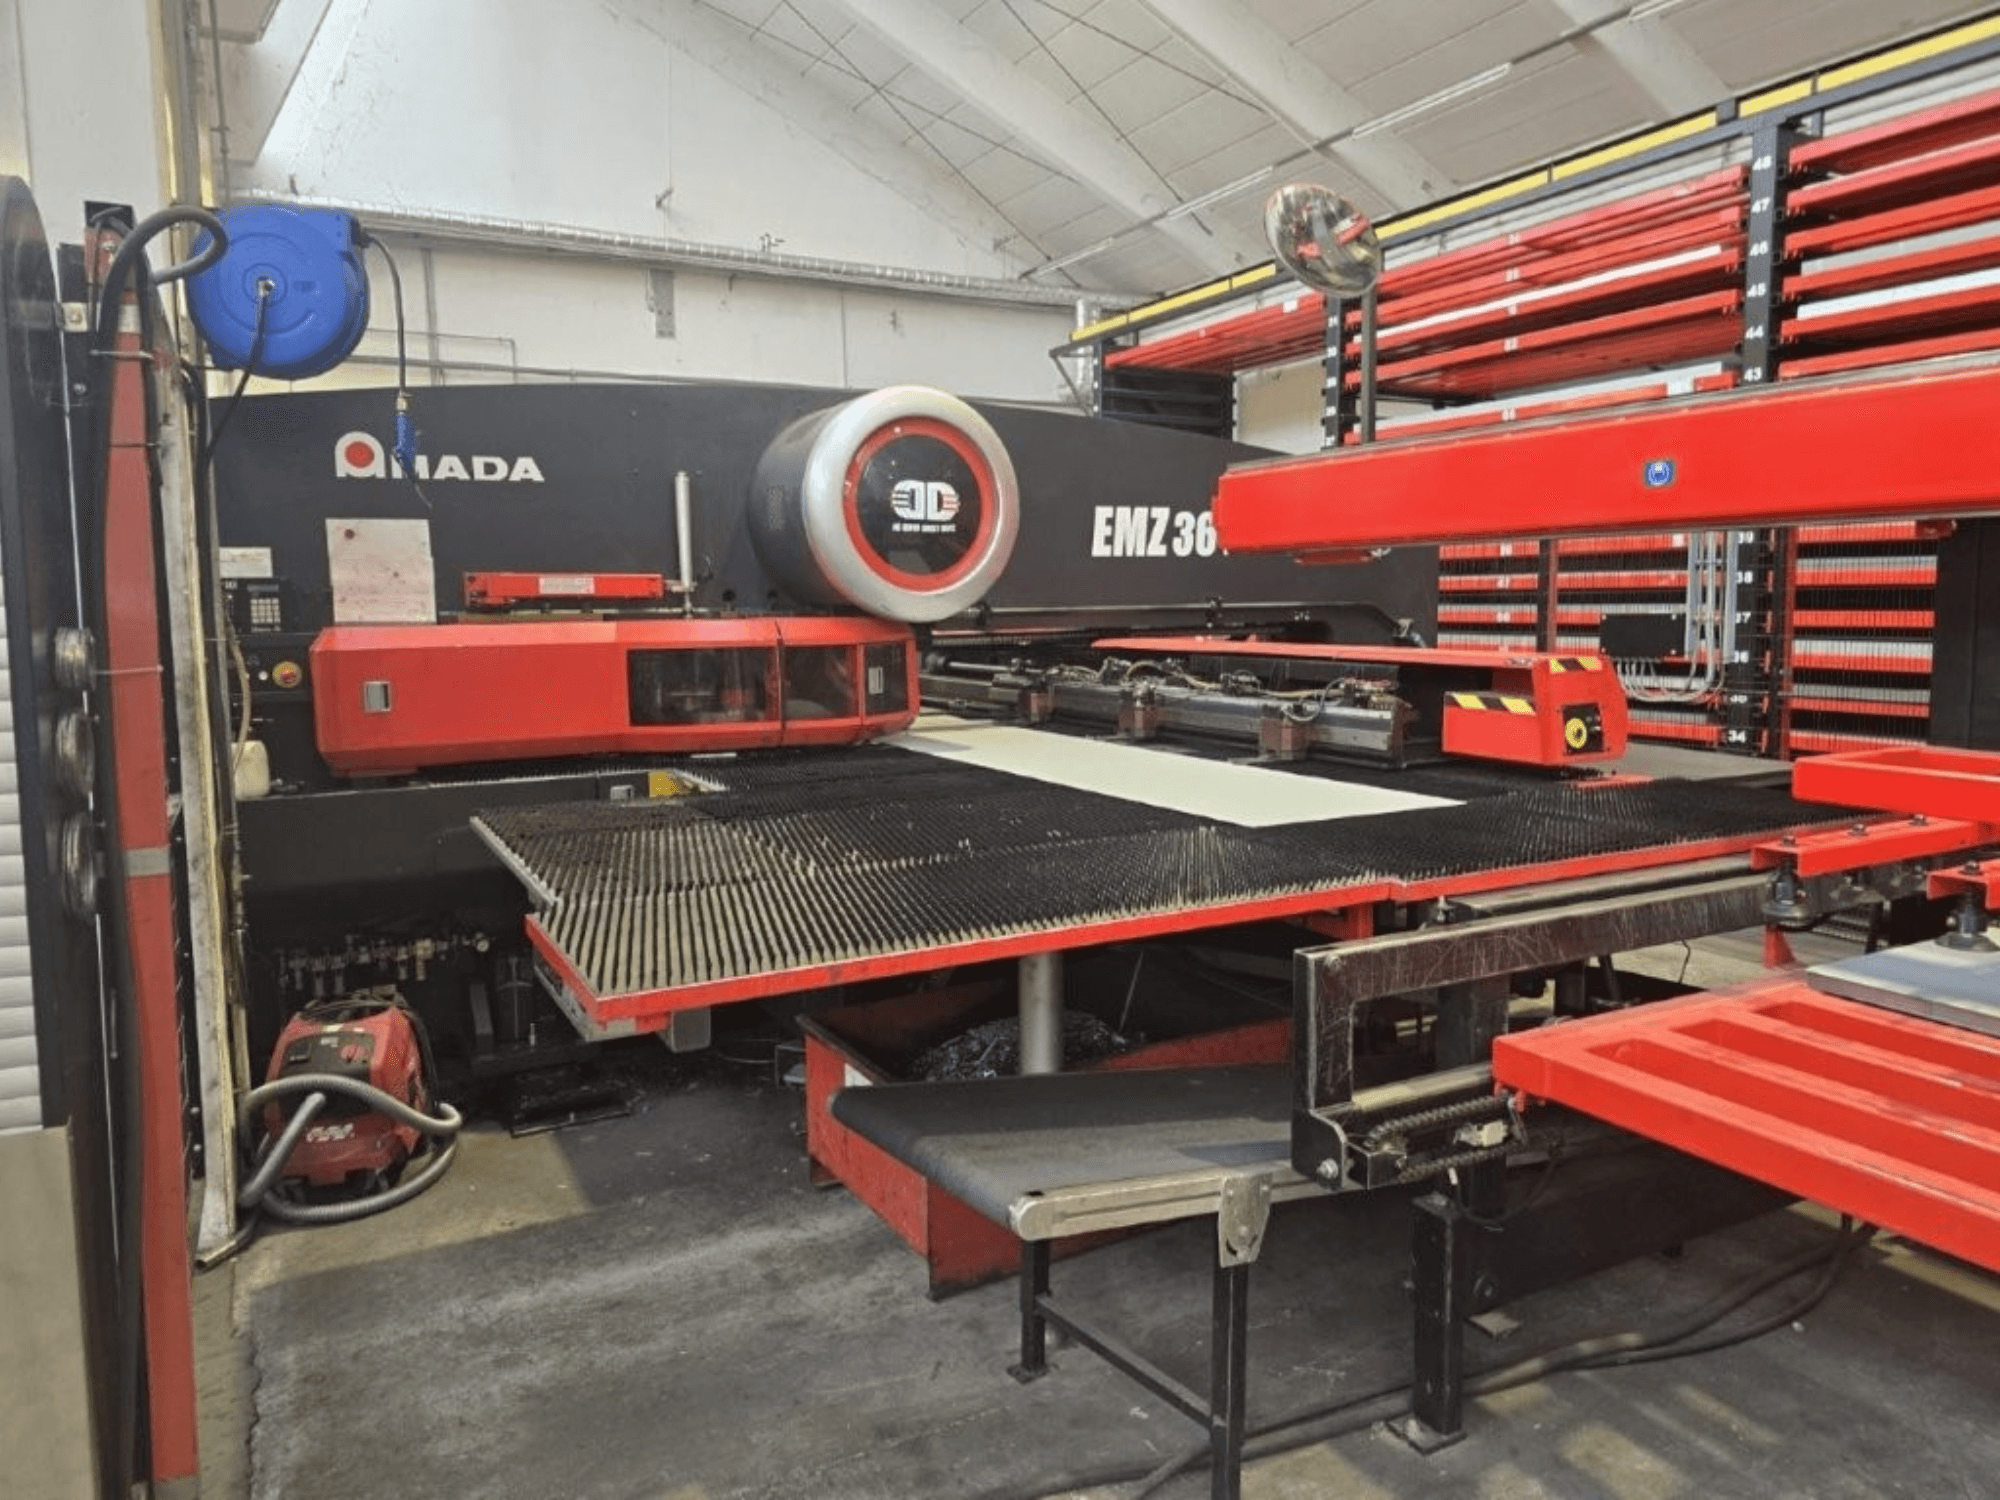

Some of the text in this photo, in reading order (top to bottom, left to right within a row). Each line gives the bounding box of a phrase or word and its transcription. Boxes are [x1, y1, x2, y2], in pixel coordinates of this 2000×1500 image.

[1751, 197, 1771, 213] 47
[1745, 325, 1764, 339] 44
[1744, 366, 1762, 381] 43
[1728, 729, 1747, 743] 34
